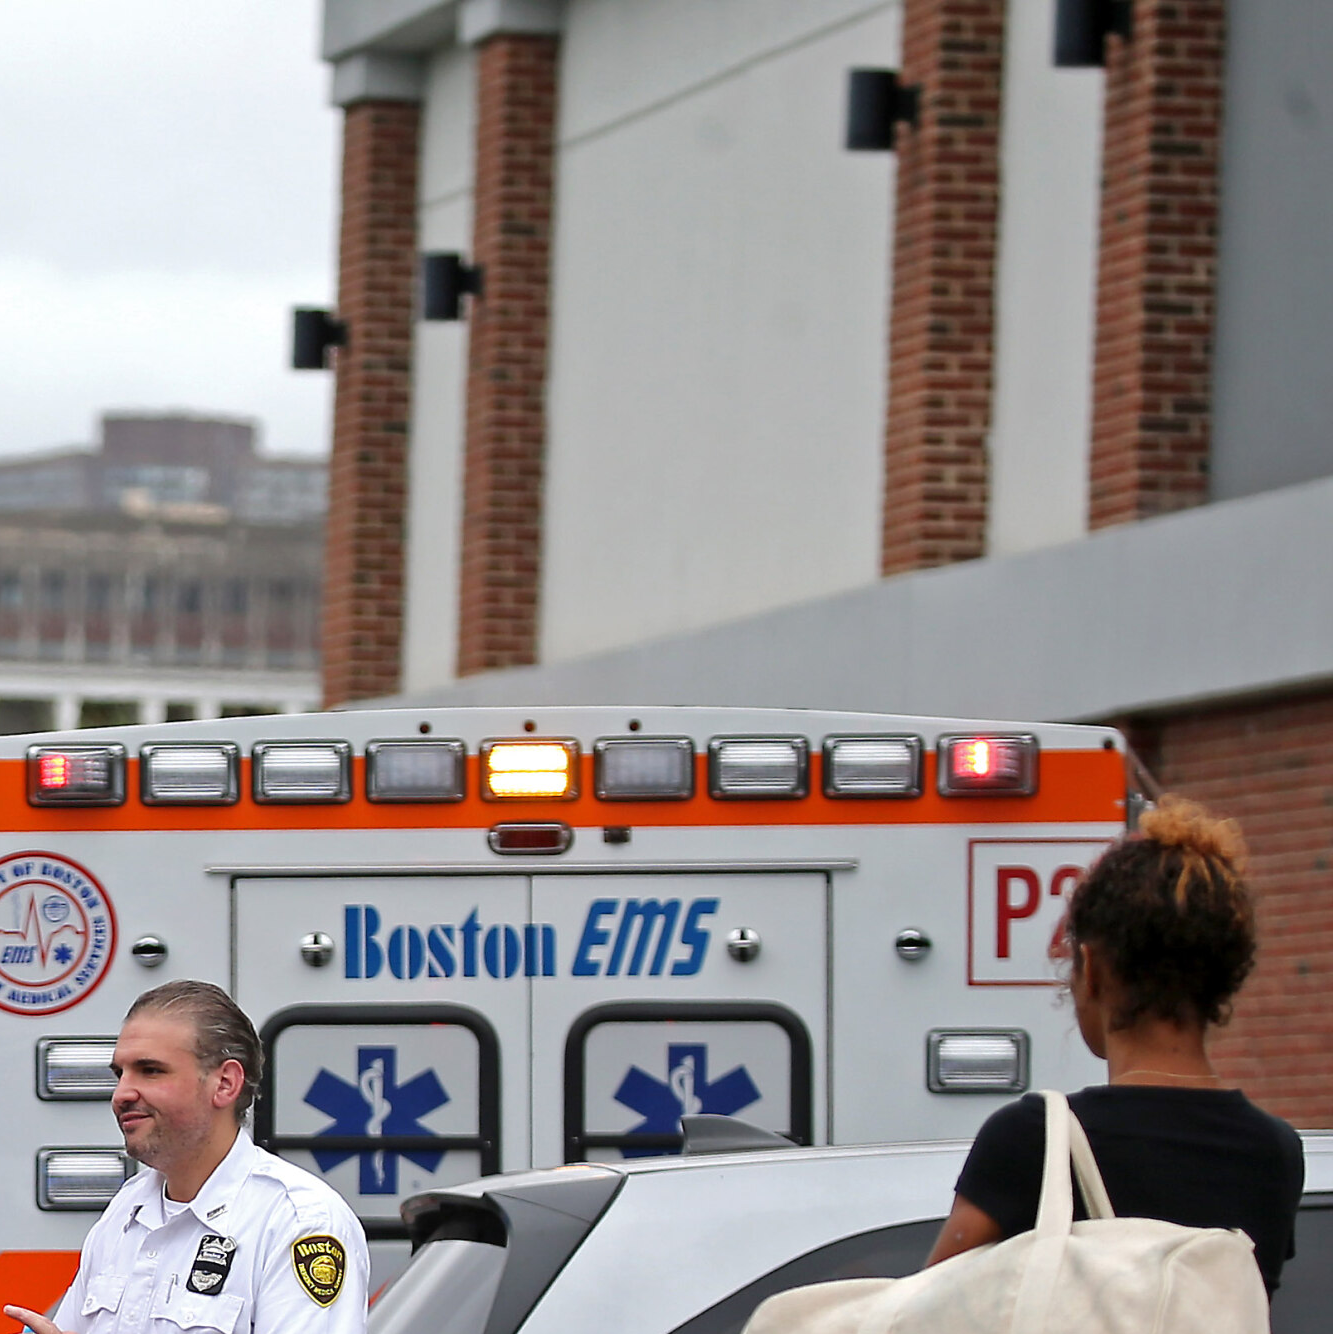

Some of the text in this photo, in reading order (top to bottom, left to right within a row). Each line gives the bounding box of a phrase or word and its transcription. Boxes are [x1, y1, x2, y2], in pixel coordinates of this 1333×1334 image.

[13, 862, 33, 877] OF
[42, 863, 100, 909] BOSTON
[1, 946, 37, 963] EMS
[344, 898, 721, 979] Boston EMS
[297, 1241, 343, 1261] Boston
